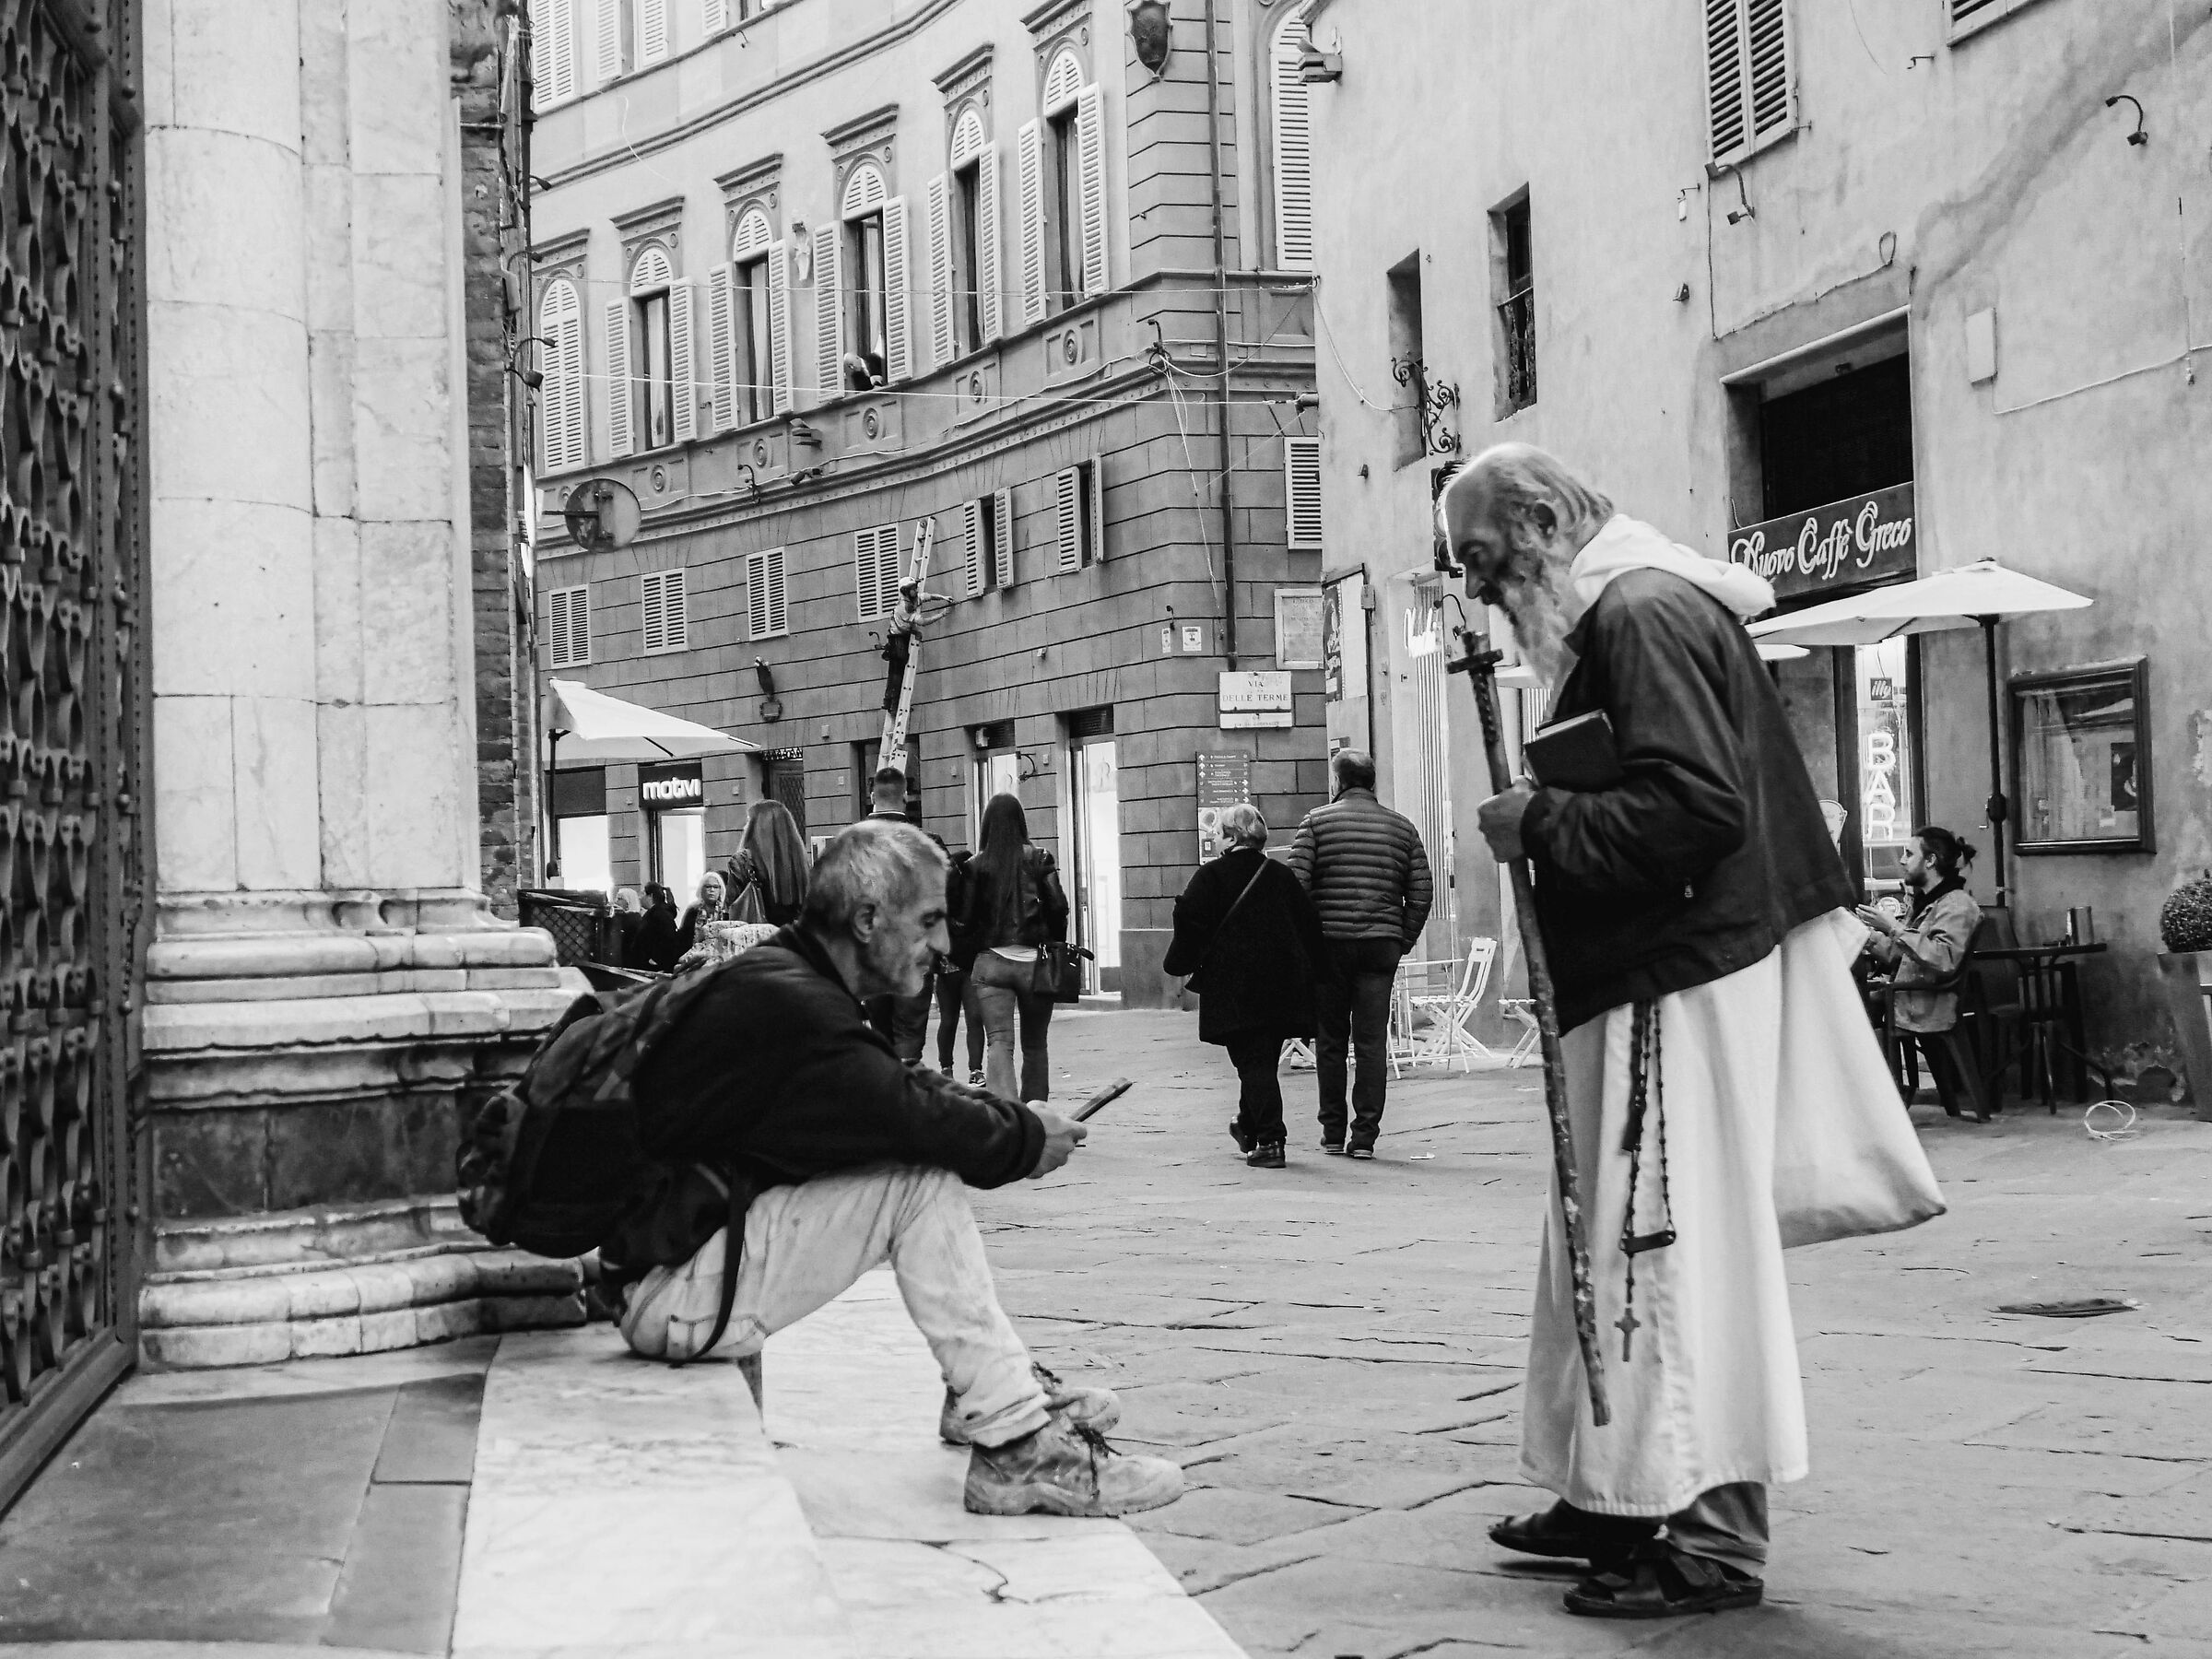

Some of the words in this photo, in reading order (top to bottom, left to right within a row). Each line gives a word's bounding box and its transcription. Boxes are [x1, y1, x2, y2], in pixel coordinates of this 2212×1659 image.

[1731, 531, 1795, 577] Nuovo
[1797, 516, 1853, 581] Caffè
[1855, 500, 1912, 568] Greco
[1222, 694, 1253, 702] DELLE
[1258, 693, 1288, 701] TERME
[1872, 679, 1892, 700] illy
[642, 776, 701, 800] motivi
[1866, 733, 1896, 842] BAR
